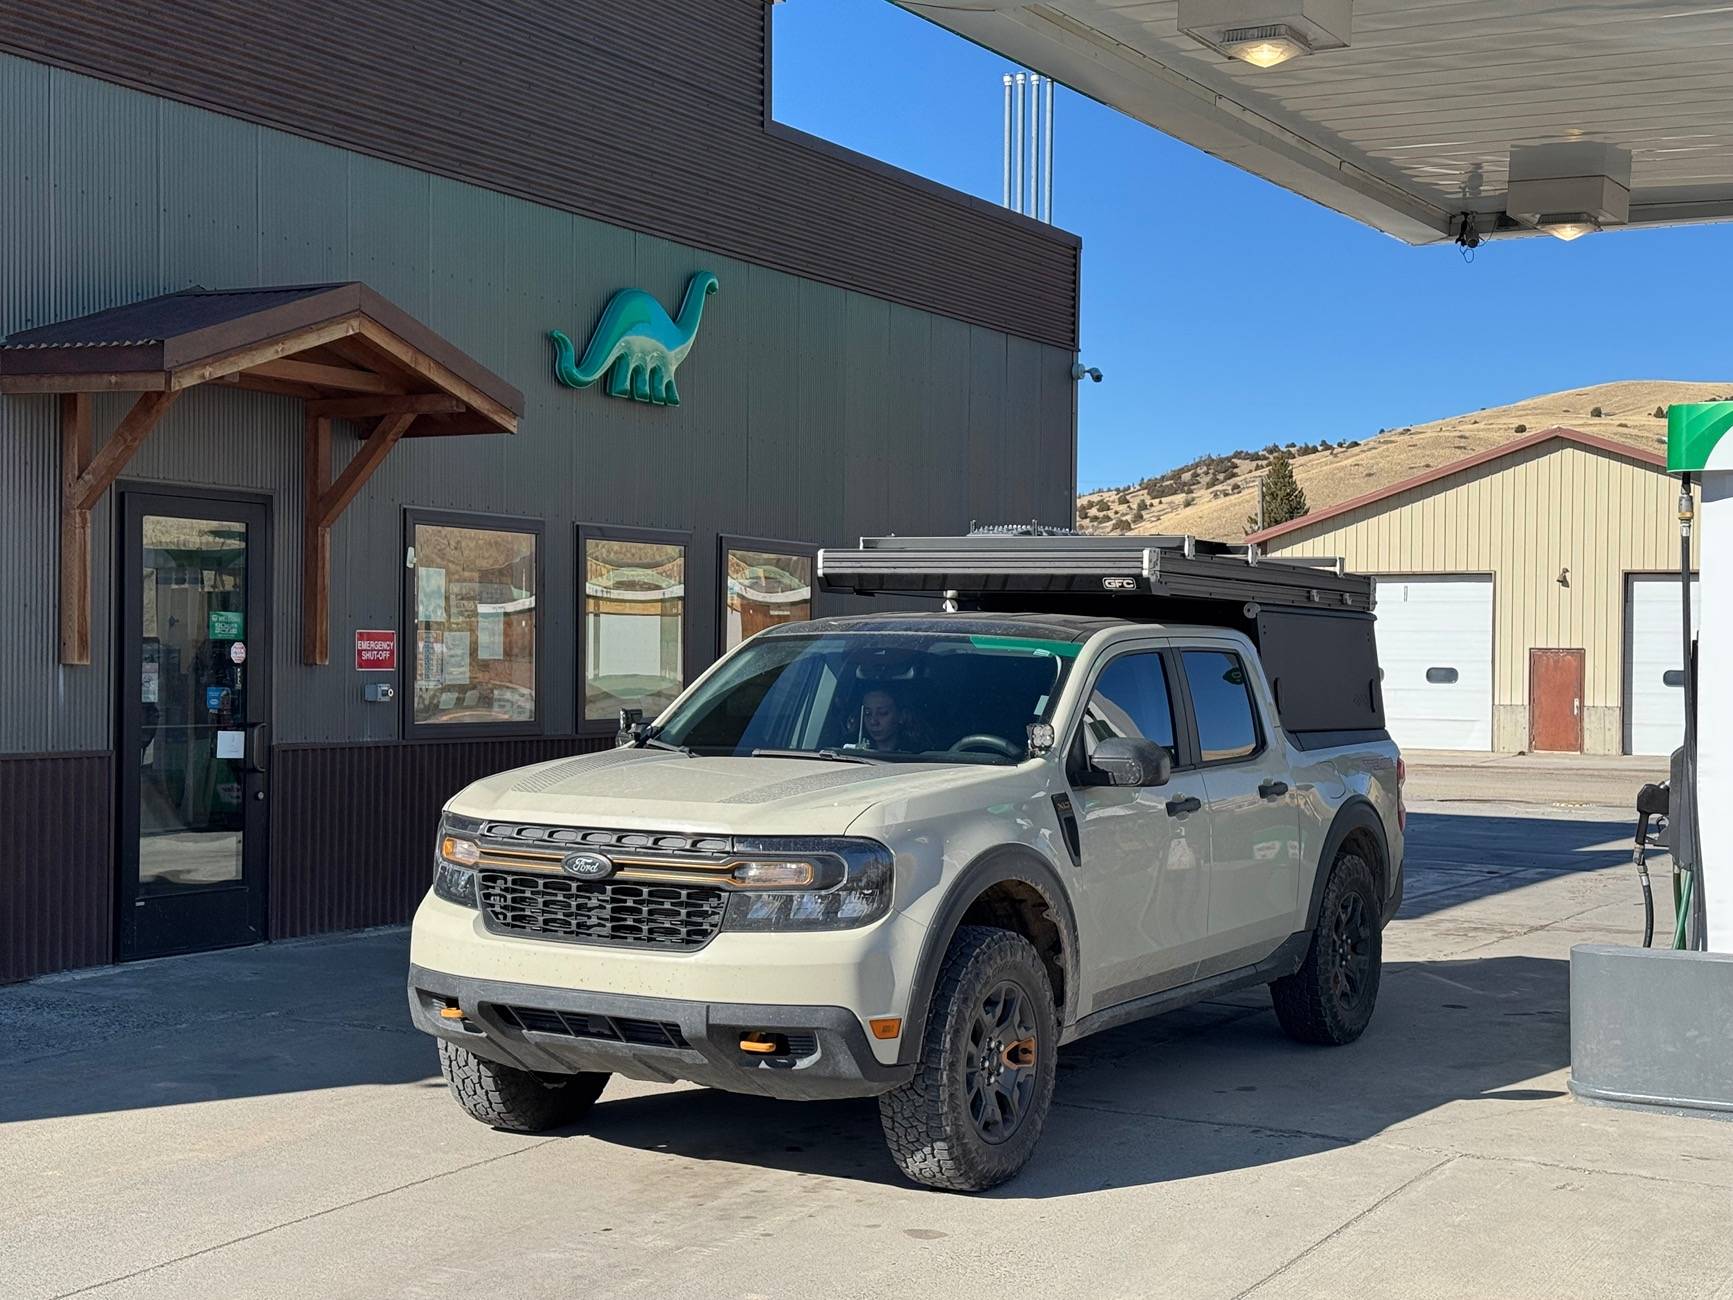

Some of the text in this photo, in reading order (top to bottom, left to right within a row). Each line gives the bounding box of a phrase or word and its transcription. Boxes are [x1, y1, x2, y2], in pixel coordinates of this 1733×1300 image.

[1105, 579, 1134, 588] GFC
[357, 640, 394, 650] EMERGENCY
[361, 651, 391, 661] SHUT-OFF
[572, 857, 600, 873] Ford
